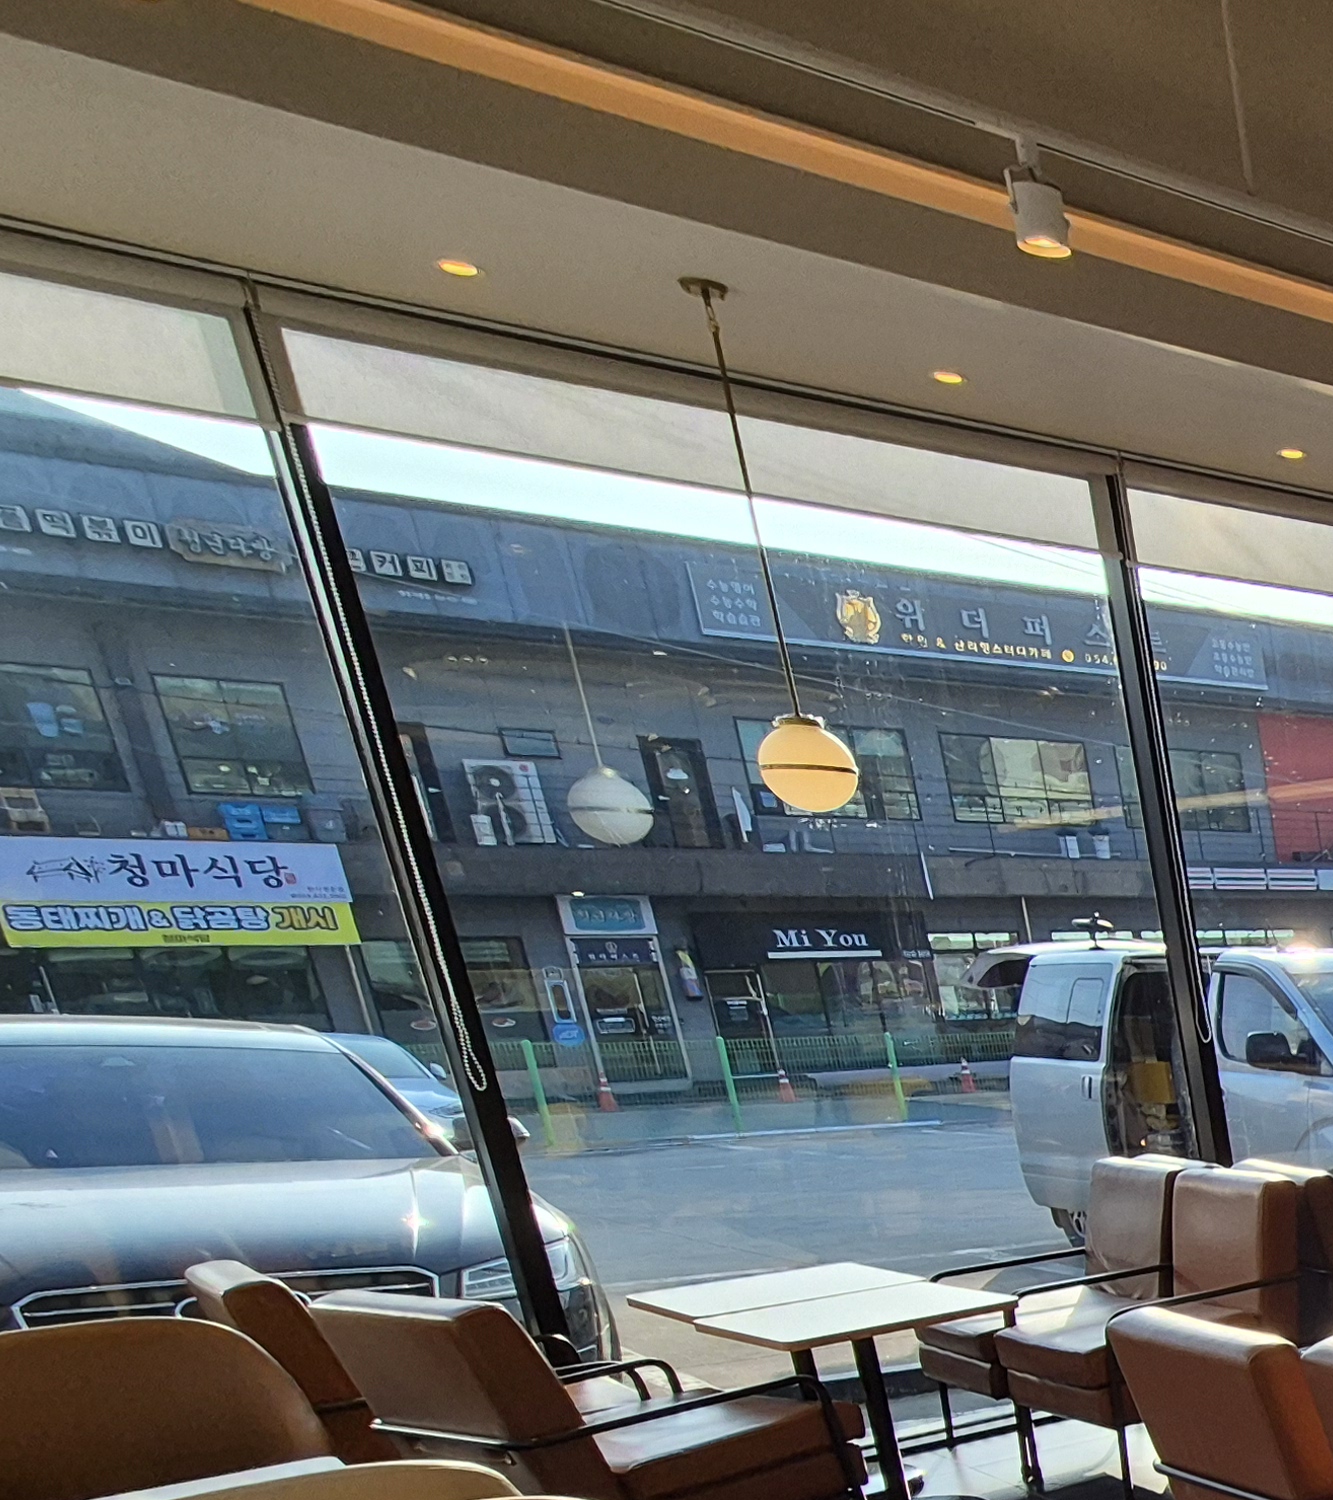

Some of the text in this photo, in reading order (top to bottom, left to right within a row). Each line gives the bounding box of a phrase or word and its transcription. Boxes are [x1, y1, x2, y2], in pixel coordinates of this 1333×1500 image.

[107, 853, 287, 888] 청마식당
[3, 904, 339, 931] 동태찌개 & 닭곰탕 개시
[773, 929, 868, 947] Mi You
